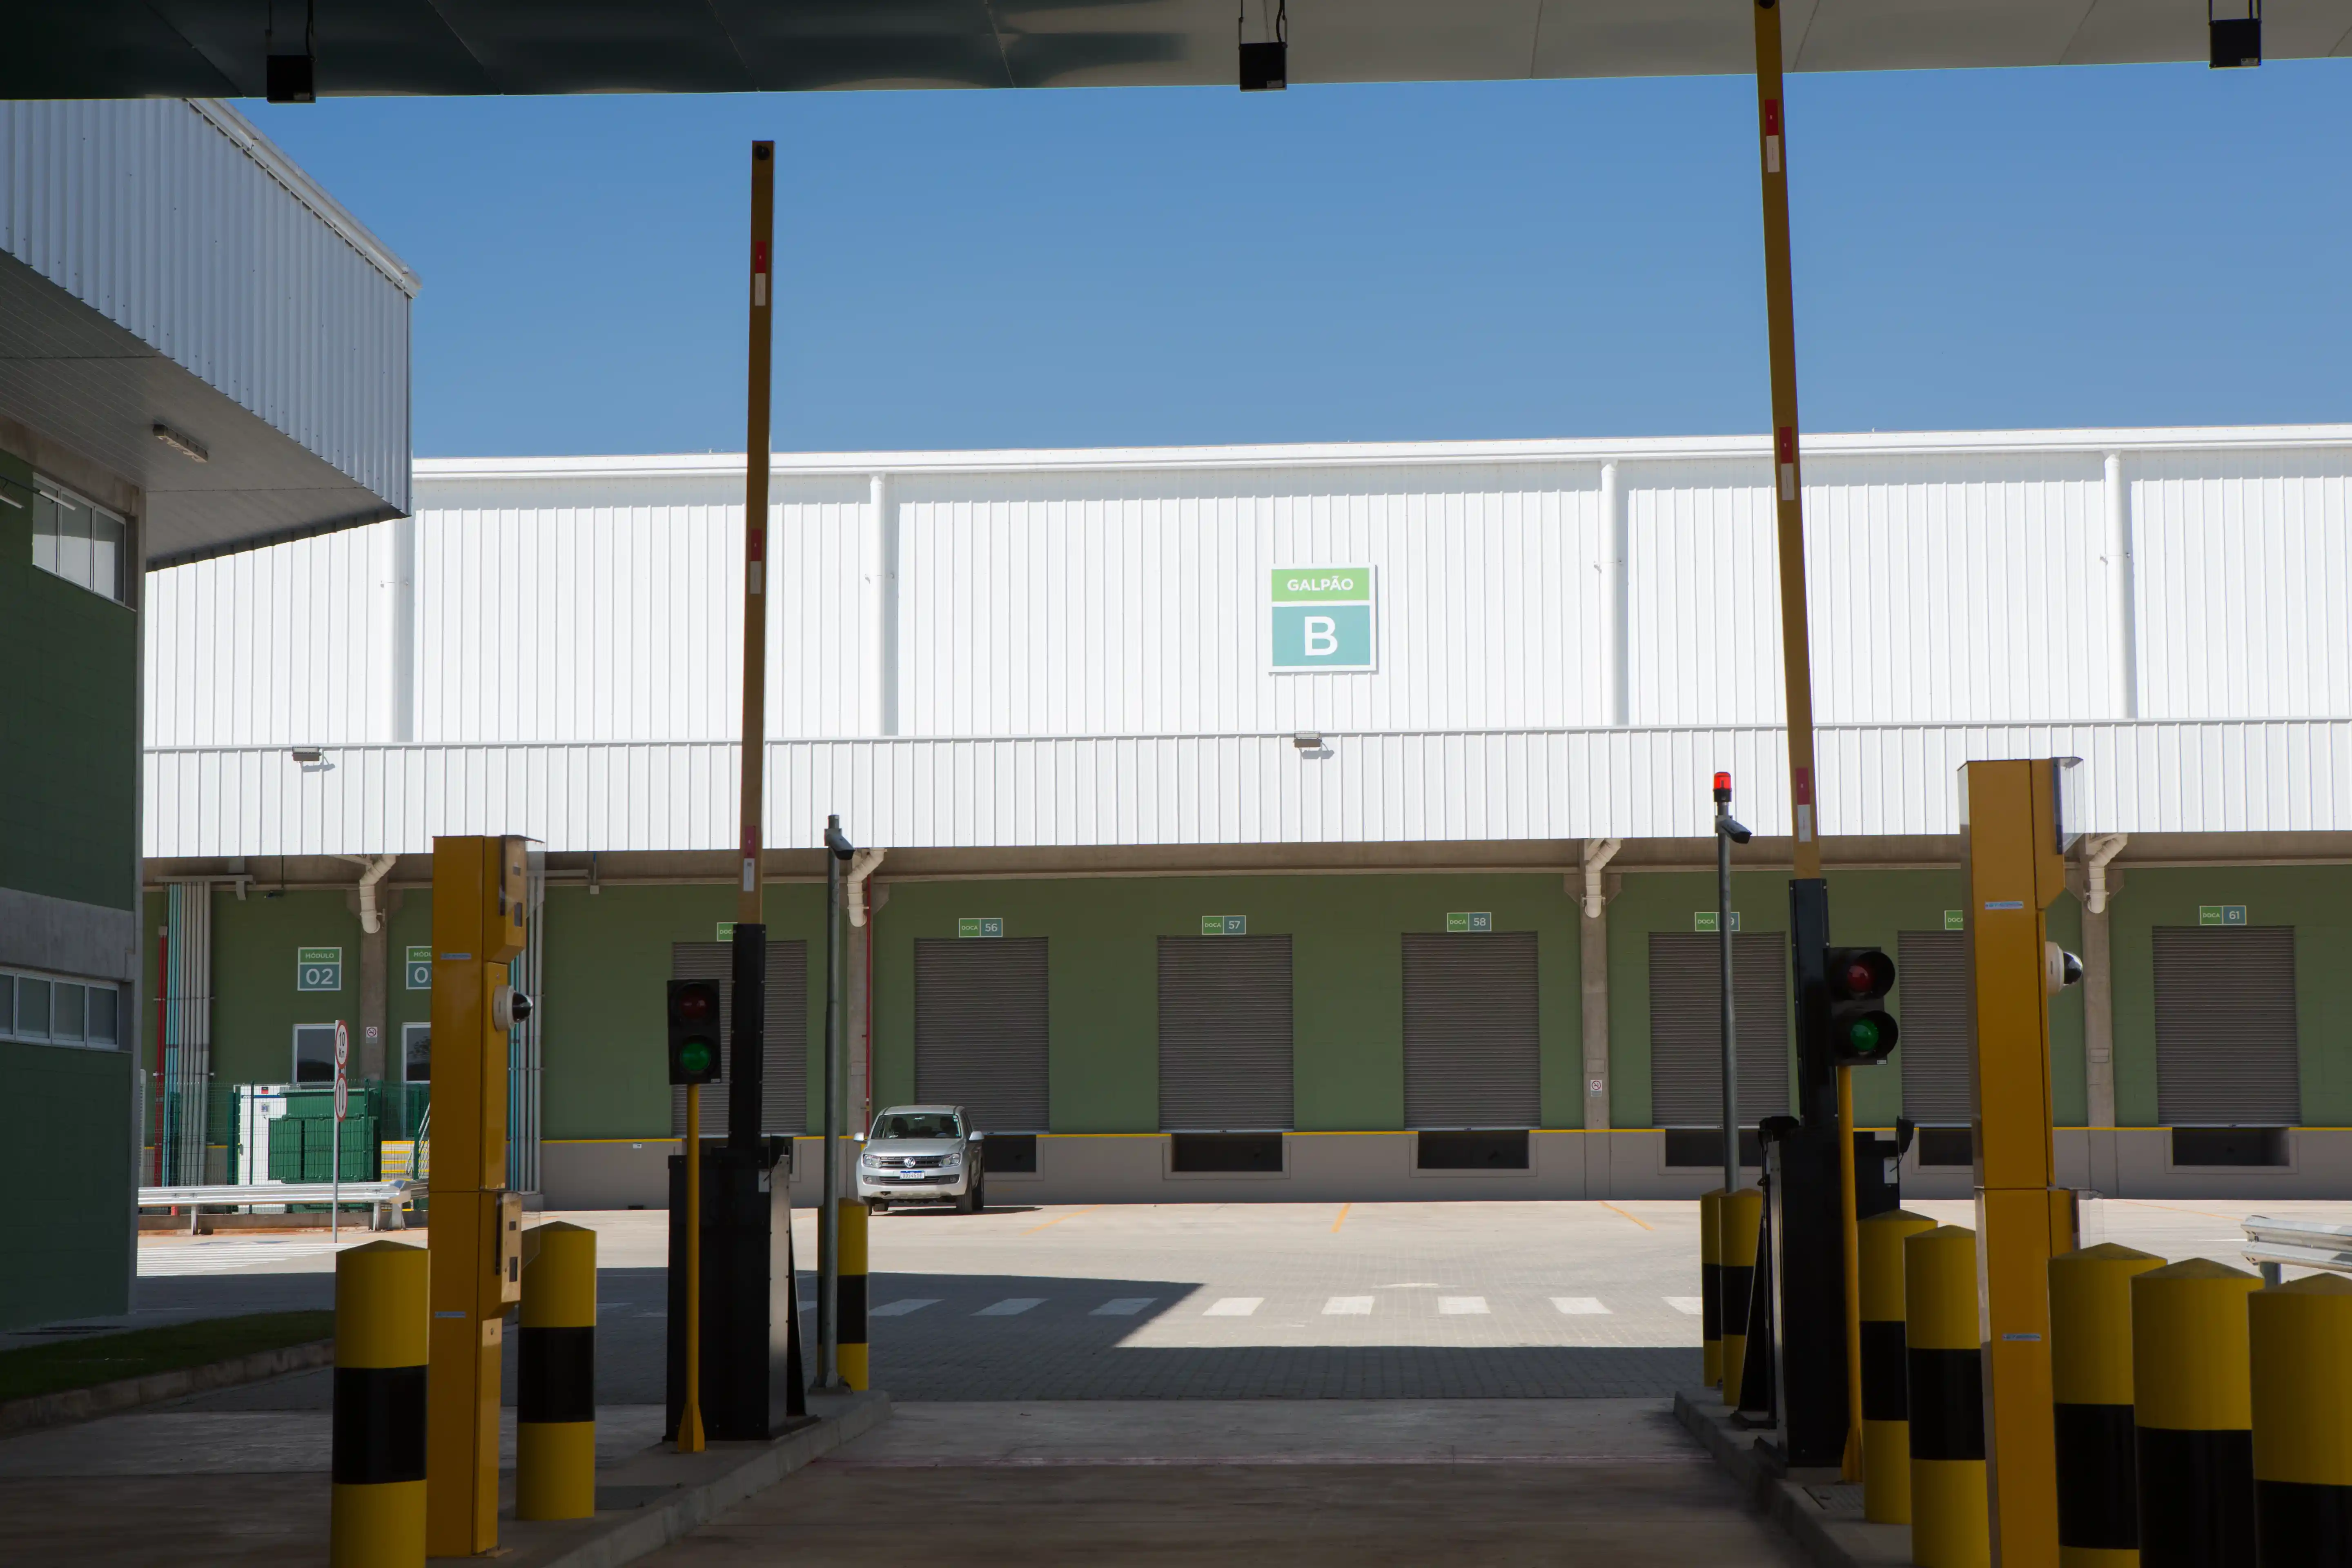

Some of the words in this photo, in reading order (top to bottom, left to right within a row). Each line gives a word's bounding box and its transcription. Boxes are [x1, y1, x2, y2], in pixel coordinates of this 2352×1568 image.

[1287, 575, 1354, 591] GALPÃO
[1304, 616, 1338, 656] B
[1474, 918, 1486, 926] 58
[2229, 911, 2240, 920] 61
[985, 923, 998, 932] 56
[1228, 920, 1241, 929] 57
[306, 968, 333, 985] 02
[414, 967, 432, 983] 0
[339, 1031, 345, 1047] 10
[339, 1047, 345, 1058] Km
